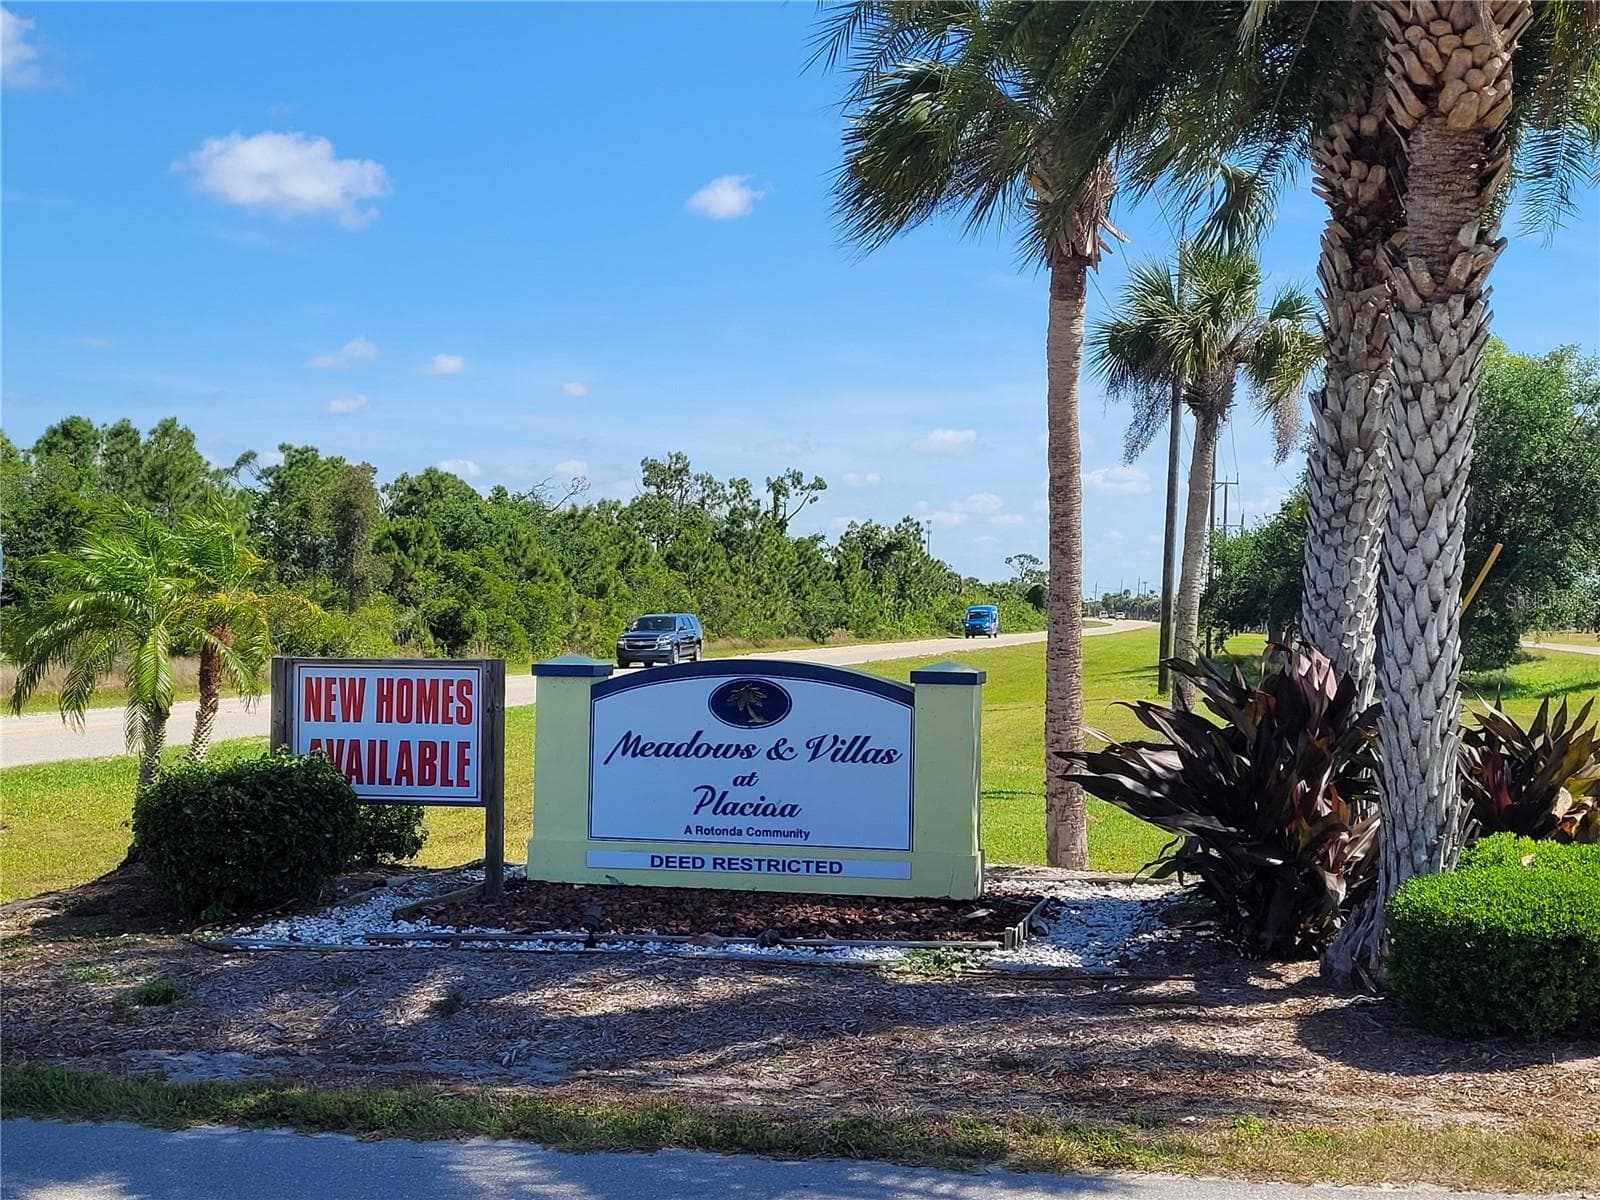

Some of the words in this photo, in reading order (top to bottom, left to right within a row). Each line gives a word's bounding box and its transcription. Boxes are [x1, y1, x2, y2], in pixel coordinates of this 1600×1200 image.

[304, 676, 366, 723] NEW
[376, 677, 473, 725] HOMES
[603, 730, 761, 765] Meadows
[766, 737, 798, 761] &
[805, 734, 903, 764] Villas
[309, 738, 471, 788] VAILABLE
[732, 771, 760, 787] at
[684, 825, 692, 835] A
[695, 825, 743, 837] Rotonda
[746, 826, 811, 841] Community
[650, 855, 705, 870] DEED
[712, 857, 843, 875] RESTRICTED
